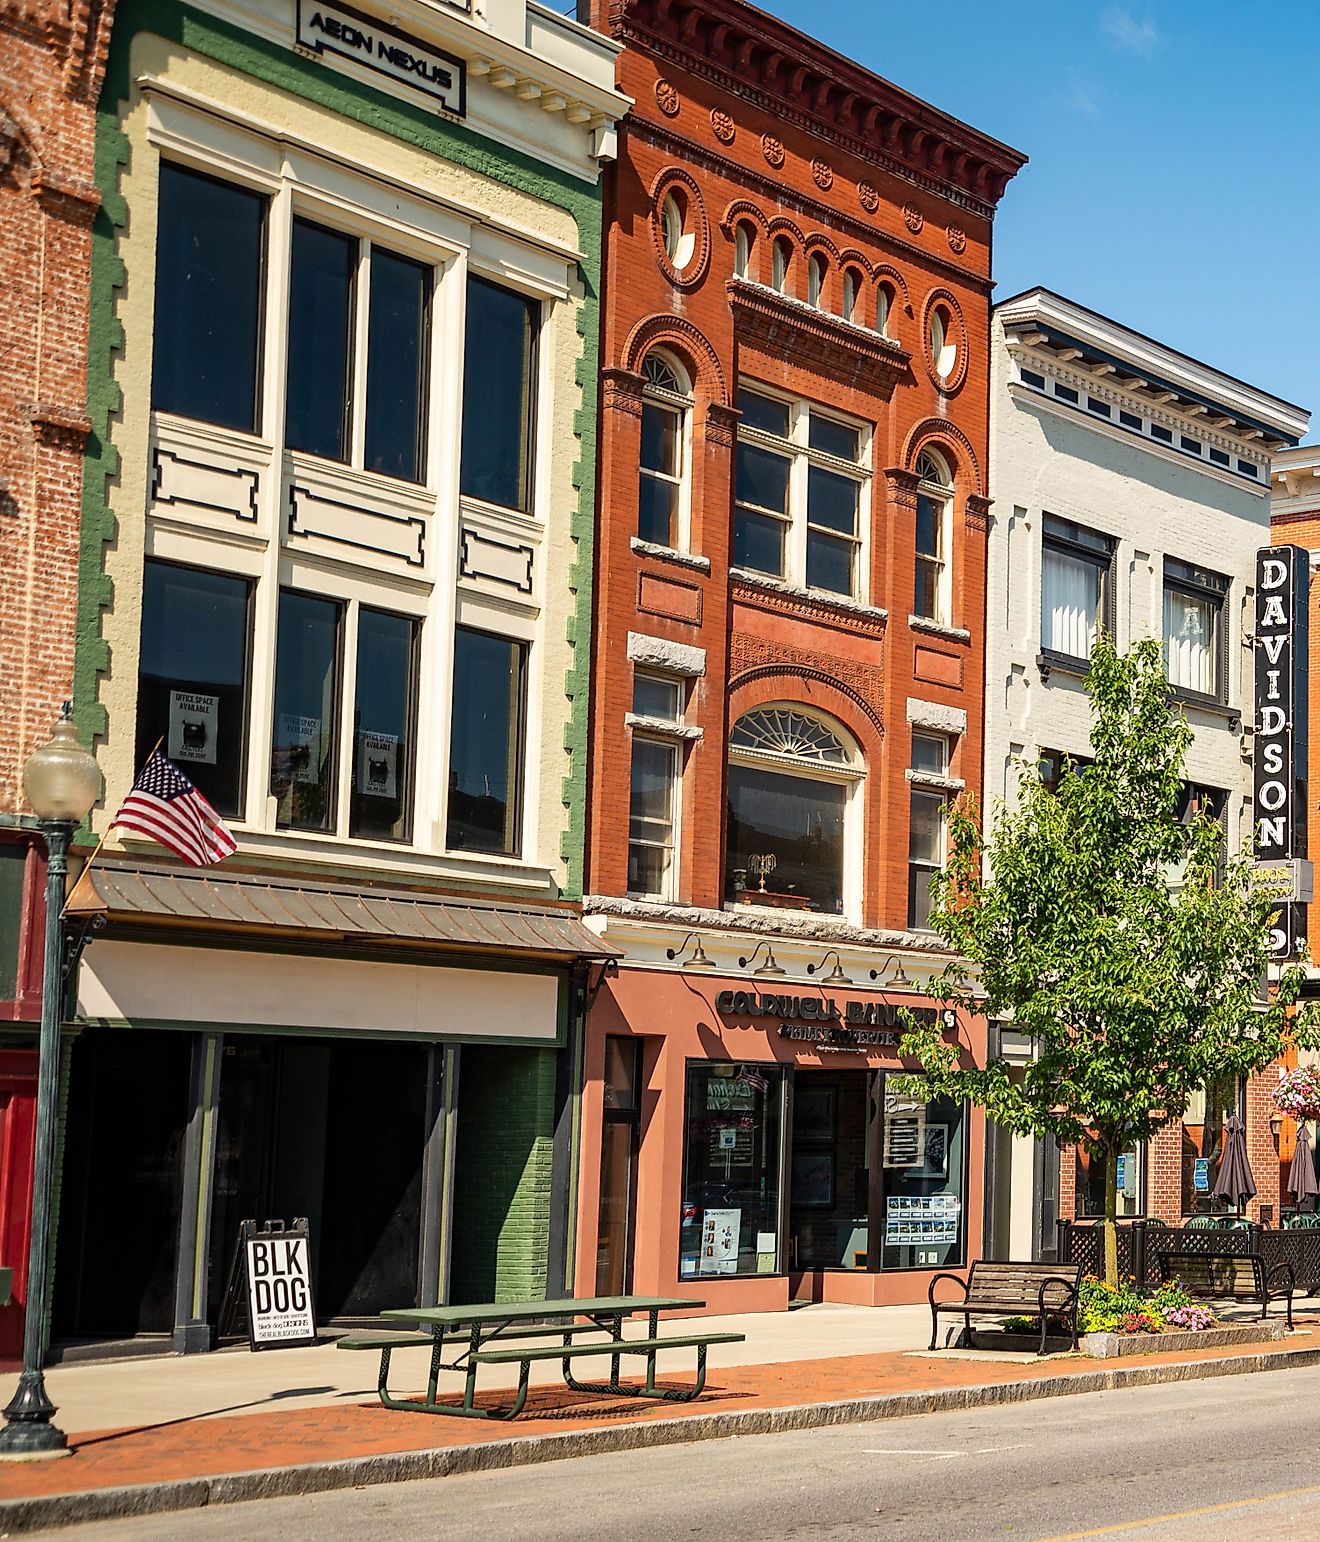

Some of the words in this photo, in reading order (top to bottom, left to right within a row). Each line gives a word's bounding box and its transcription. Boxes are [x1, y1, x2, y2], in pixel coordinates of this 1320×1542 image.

[310, 12, 373, 54] AEON
[378, 41, 452, 90] NEXUS
[176, 693, 194, 703] OFFICE
[195, 696, 214, 706] SPACE
[179, 702, 210, 713] AVAILABLE
[1259, 560, 1289, 847] DAVIDSON
[366, 741, 391, 752] AVAILABLE
[379, 735, 394, 744] SPACE
[252, 1241, 303, 1277] BLK
[255, 1277, 306, 1314] DOG
